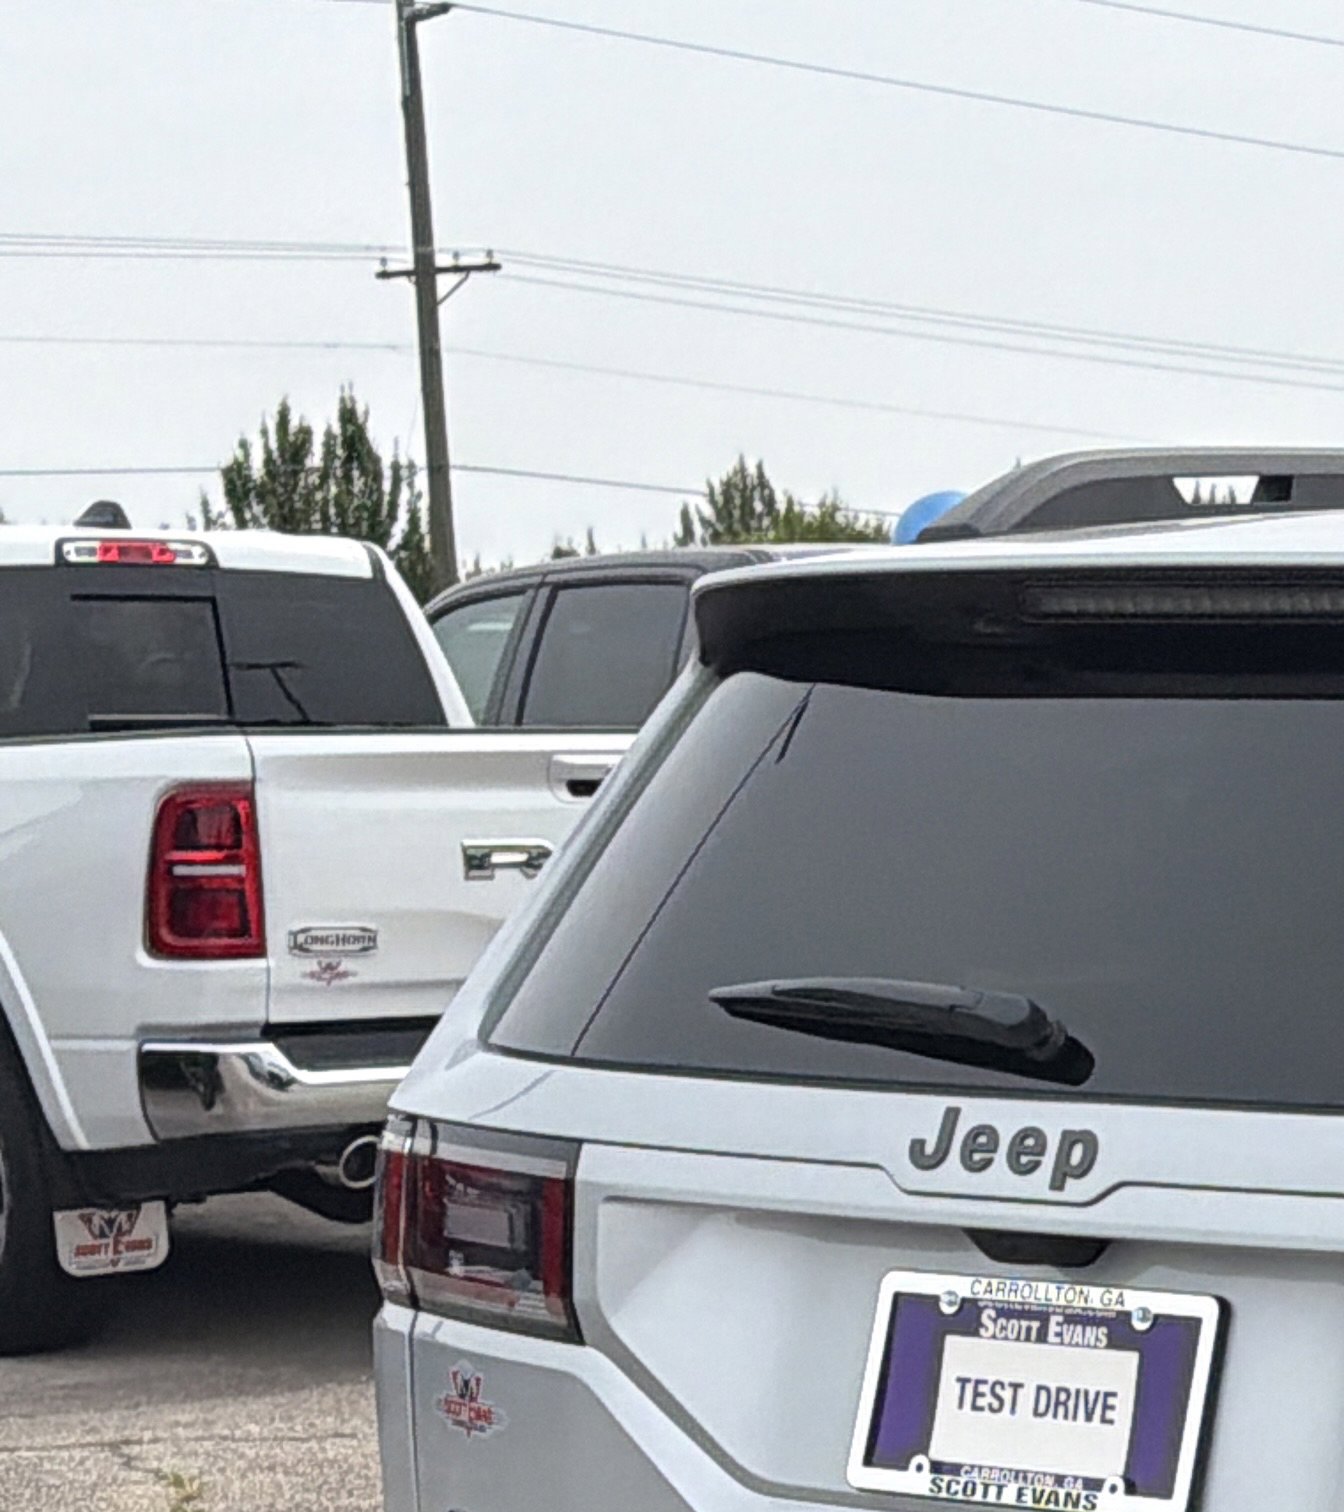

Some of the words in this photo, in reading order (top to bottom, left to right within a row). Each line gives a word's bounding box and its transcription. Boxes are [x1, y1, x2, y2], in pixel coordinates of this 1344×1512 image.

[908, 1105, 1099, 1191] Jeep
[1100, 1288, 1126, 1308] GA
[979, 1308, 1041, 1344] SCOTT
[1047, 1315, 1109, 1349] EVANS
[955, 1375, 1025, 1417] TEST
[1032, 1384, 1119, 1426] DRIVE
[929, 1475, 1008, 1502] SCOTT
[1015, 1485, 1099, 1512] EVANS
